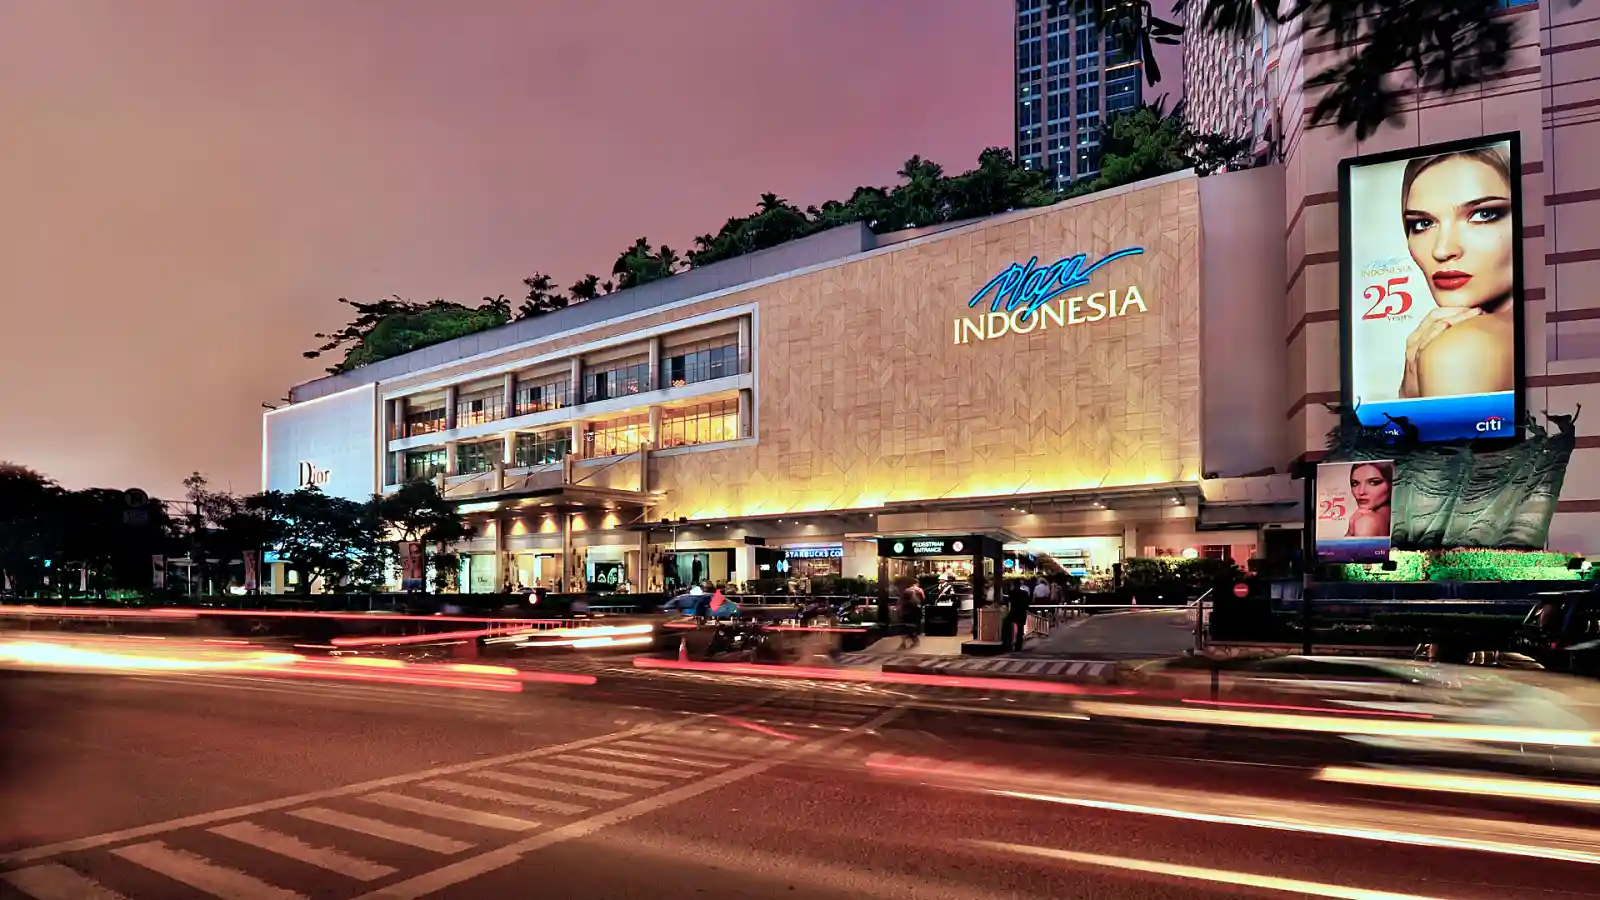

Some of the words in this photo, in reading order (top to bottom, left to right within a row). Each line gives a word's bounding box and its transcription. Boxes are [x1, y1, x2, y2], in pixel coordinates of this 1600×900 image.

[1361, 265, 1413, 277] INDONESIA
[968, 247, 1144, 321] Plaza
[1362, 276, 1412, 320] 25
[953, 285, 1148, 345] INDONESIA
[1476, 417, 1502, 432] citi
[299, 461, 330, 486] Dior
[1318, 497, 1347, 520] 25
[785, 550, 829, 558] STARBUCKS
